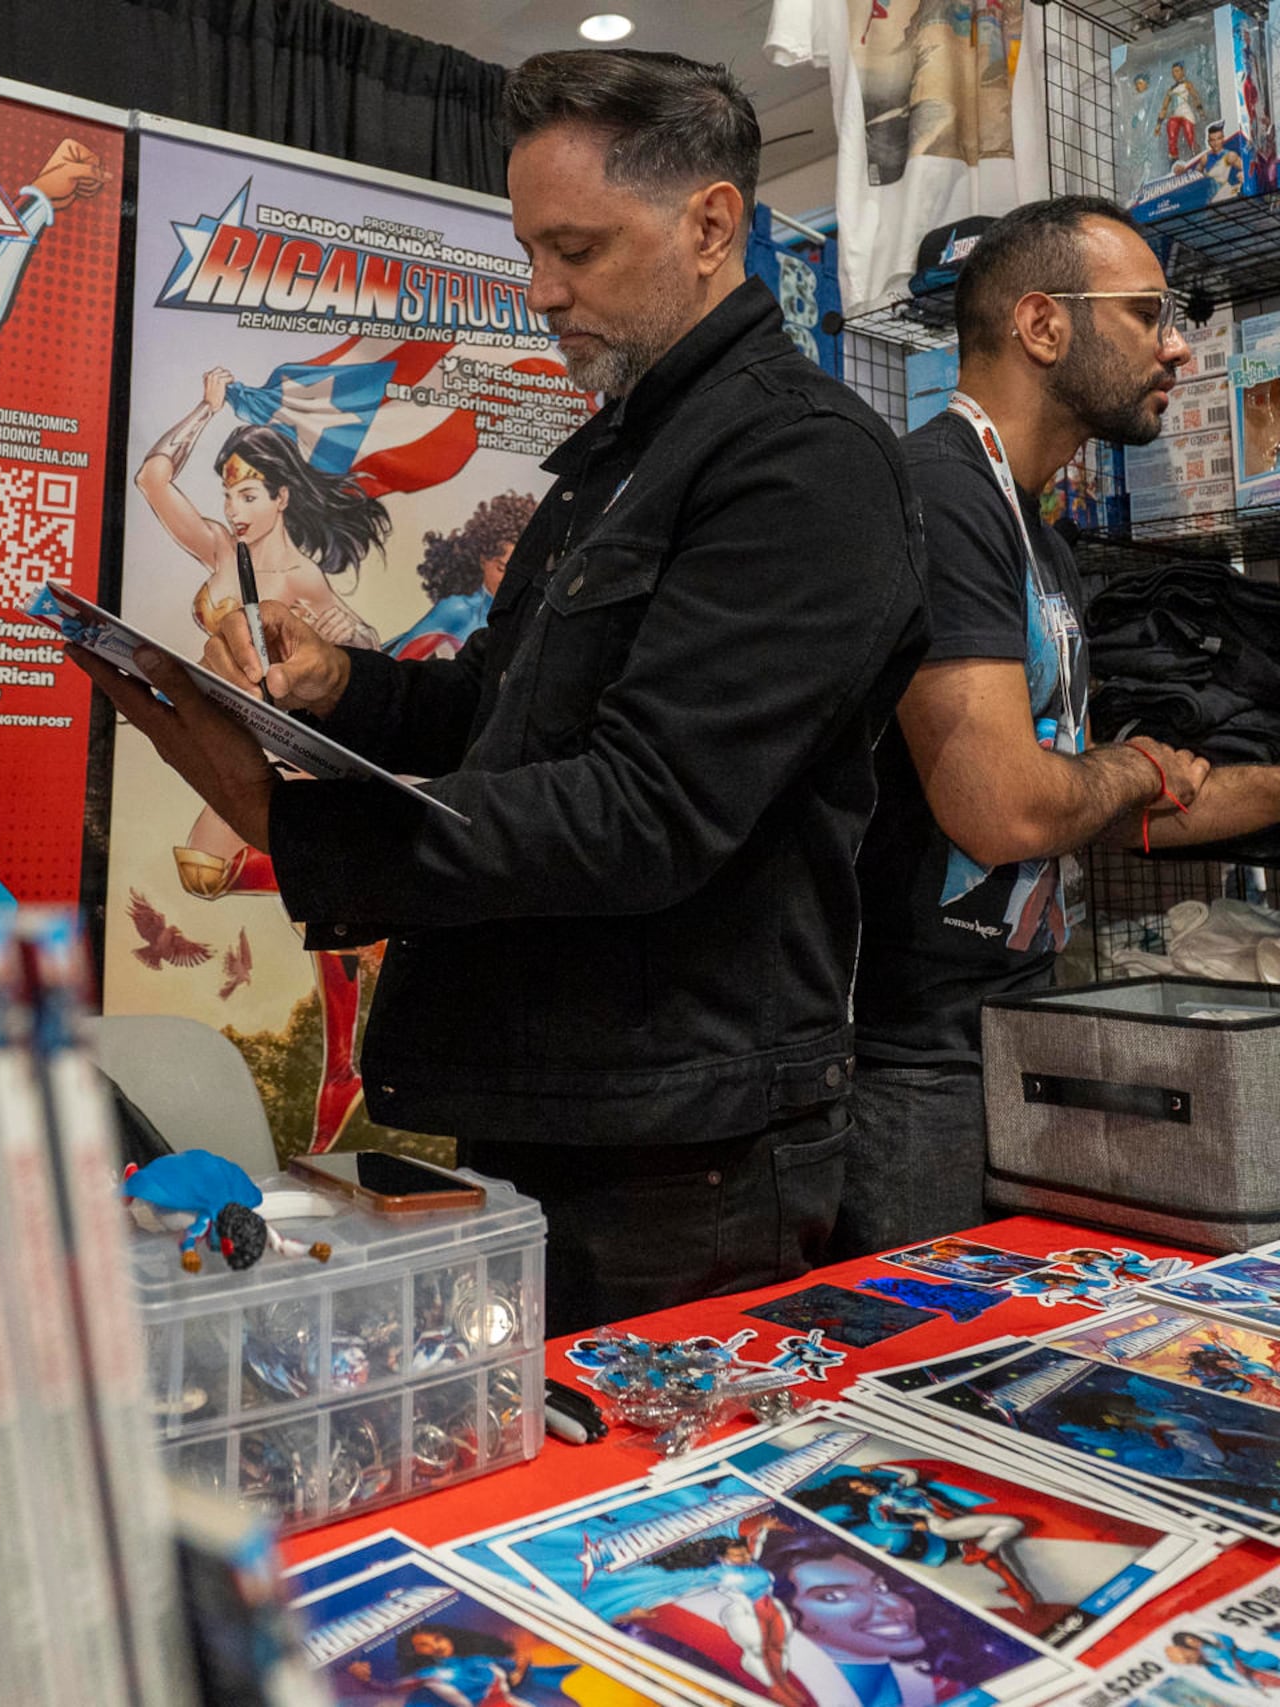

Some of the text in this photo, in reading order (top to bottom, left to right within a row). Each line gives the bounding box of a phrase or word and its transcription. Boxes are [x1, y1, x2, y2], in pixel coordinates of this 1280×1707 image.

[257, 205, 351, 242] EDGARDO
[363, 216, 444, 243] PRODUCED BY
[238, 311, 550, 350] REMINISCING & REBUILDING PUERTO RICO
[413, 387, 587, 426] @LaBorinquenaComics
[442, 373, 587, 410] La-Borinquena.com
[38, 716, 73, 728] POST
[1105, 1660, 1164, 1697] $200
